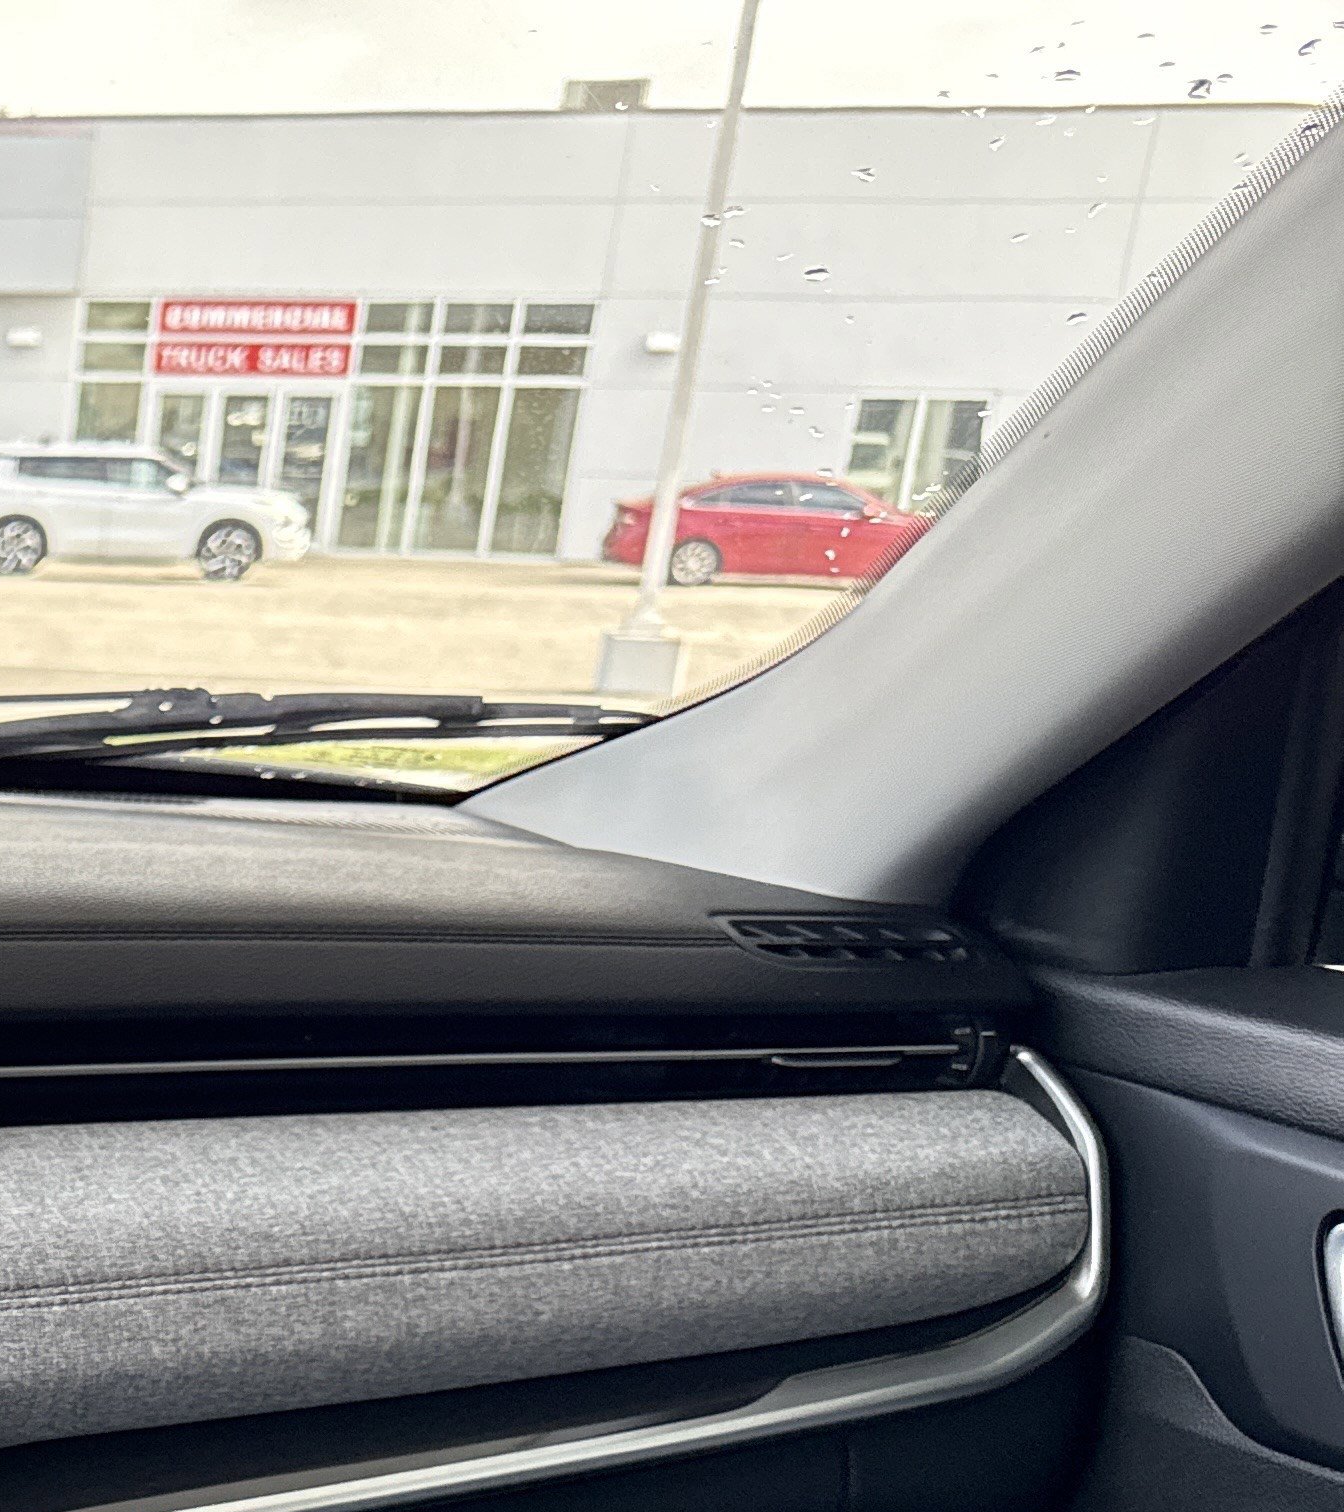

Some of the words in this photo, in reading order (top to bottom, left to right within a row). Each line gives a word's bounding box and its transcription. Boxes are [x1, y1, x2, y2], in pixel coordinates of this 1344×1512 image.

[164, 304, 349, 331] COMMERCIAL
[160, 346, 249, 373] TRUCK
[257, 346, 344, 373] SALES
